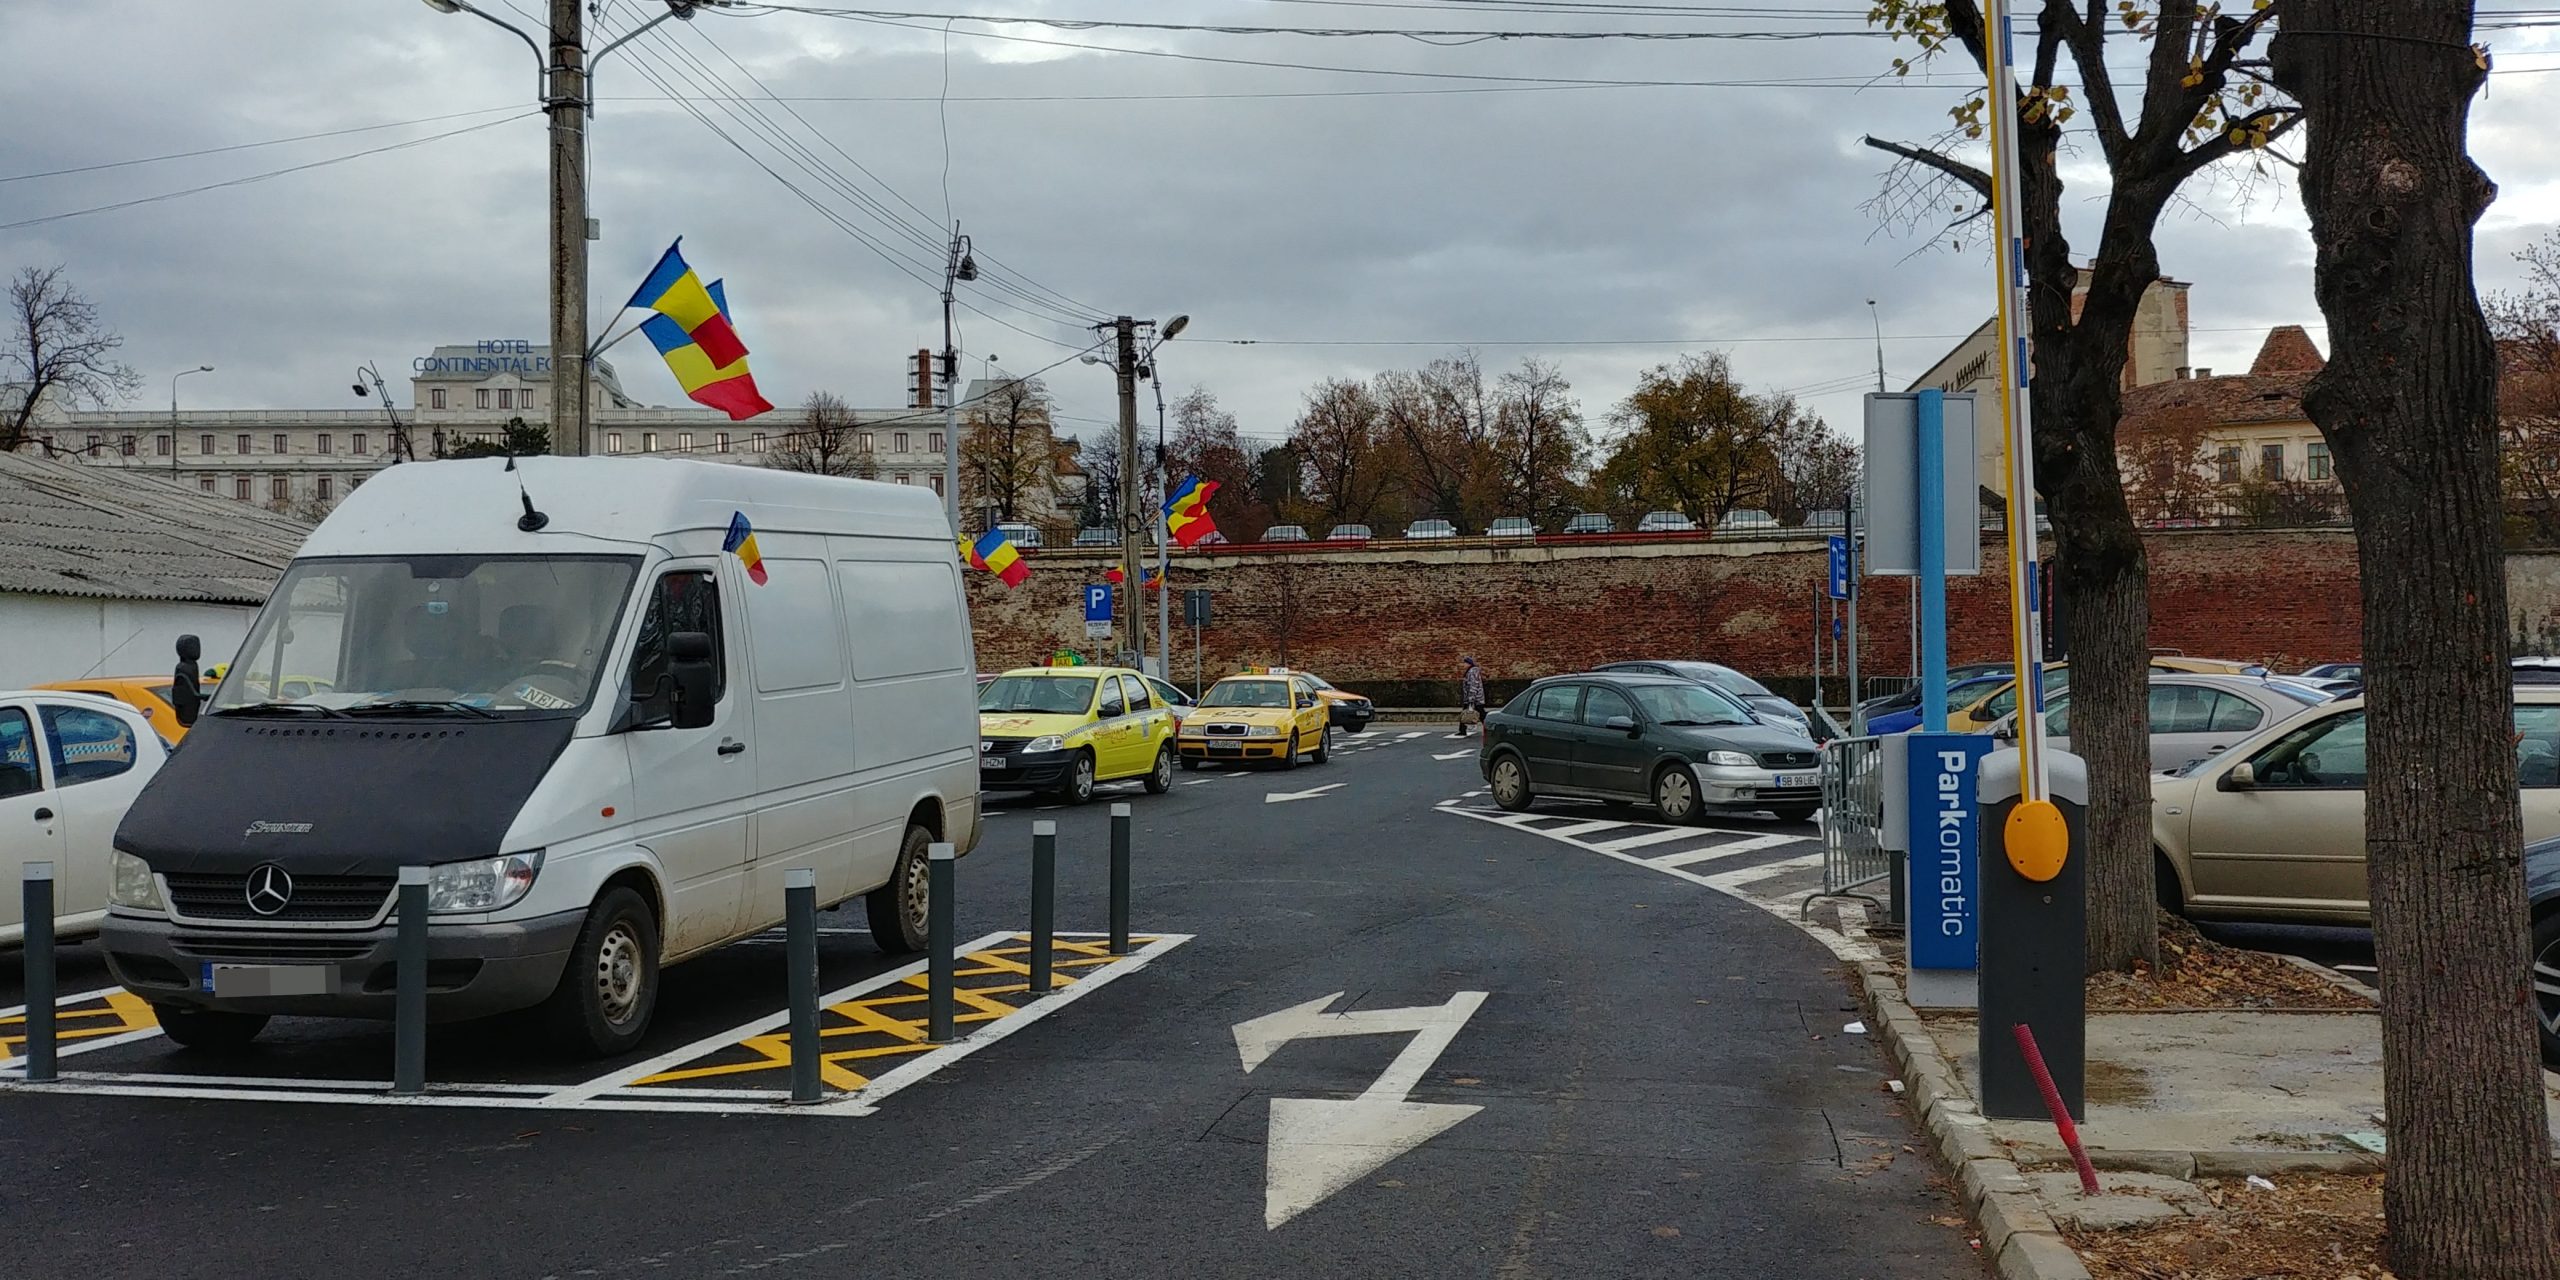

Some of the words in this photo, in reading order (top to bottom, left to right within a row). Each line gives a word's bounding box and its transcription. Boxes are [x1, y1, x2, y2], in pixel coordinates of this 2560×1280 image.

[477, 340, 534, 353] HOTEL
[413, 357, 533, 372] CONTINENTAL
[1091, 589, 1105, 608] P
[1055, 657, 1071, 667] TAXI
[1781, 776, 1793, 786] SB
[1794, 776, 1803, 786] 99
[1937, 750, 1970, 936] Parkomatic
